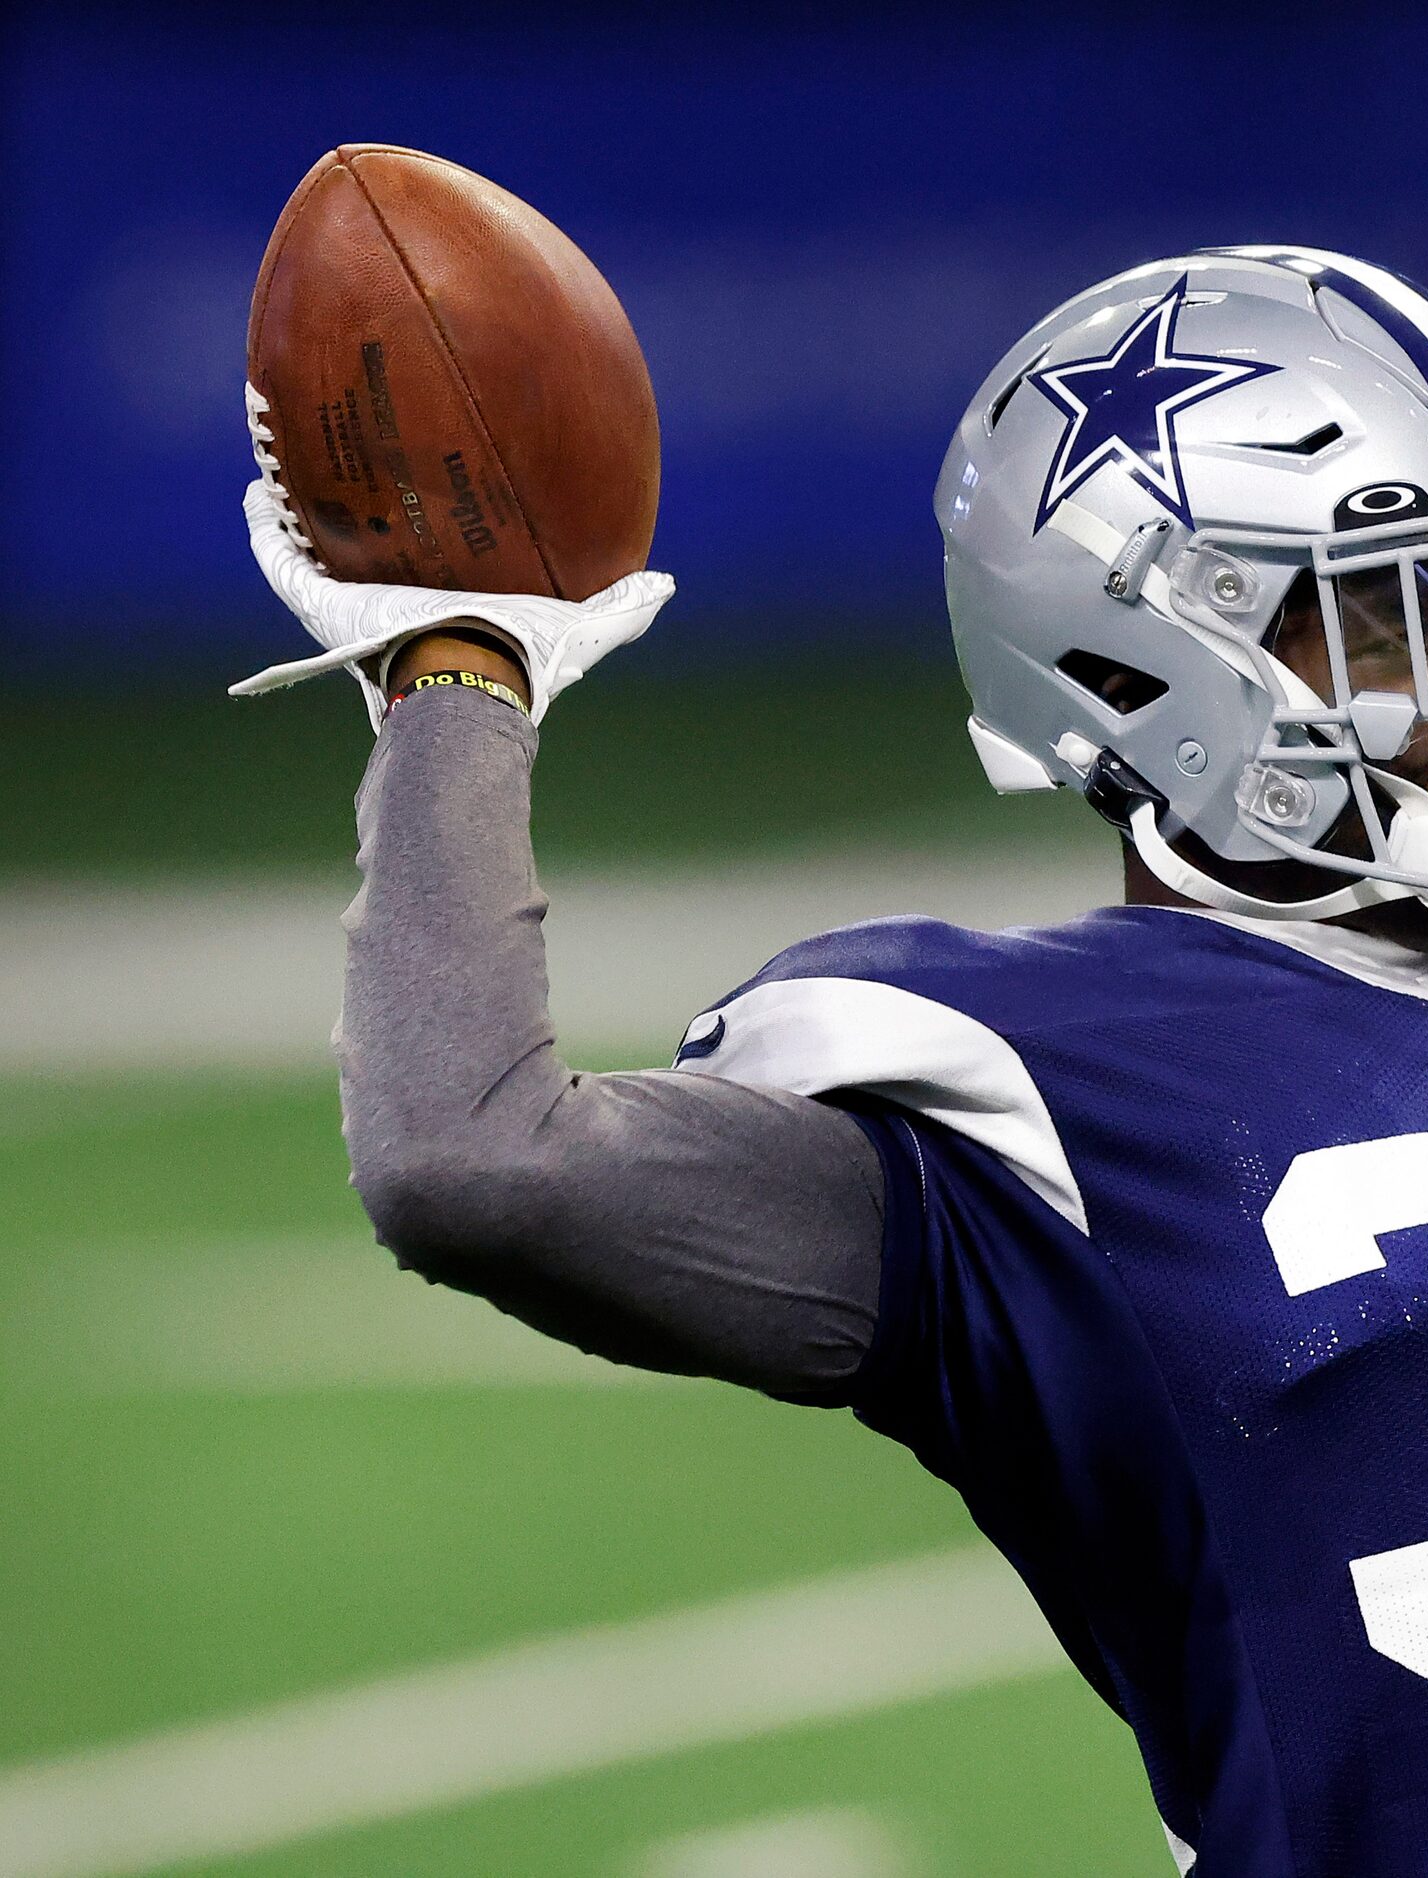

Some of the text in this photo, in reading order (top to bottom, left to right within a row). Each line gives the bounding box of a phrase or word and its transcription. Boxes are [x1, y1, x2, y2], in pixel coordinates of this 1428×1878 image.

[415, 671, 530, 719] Do Big Thi
